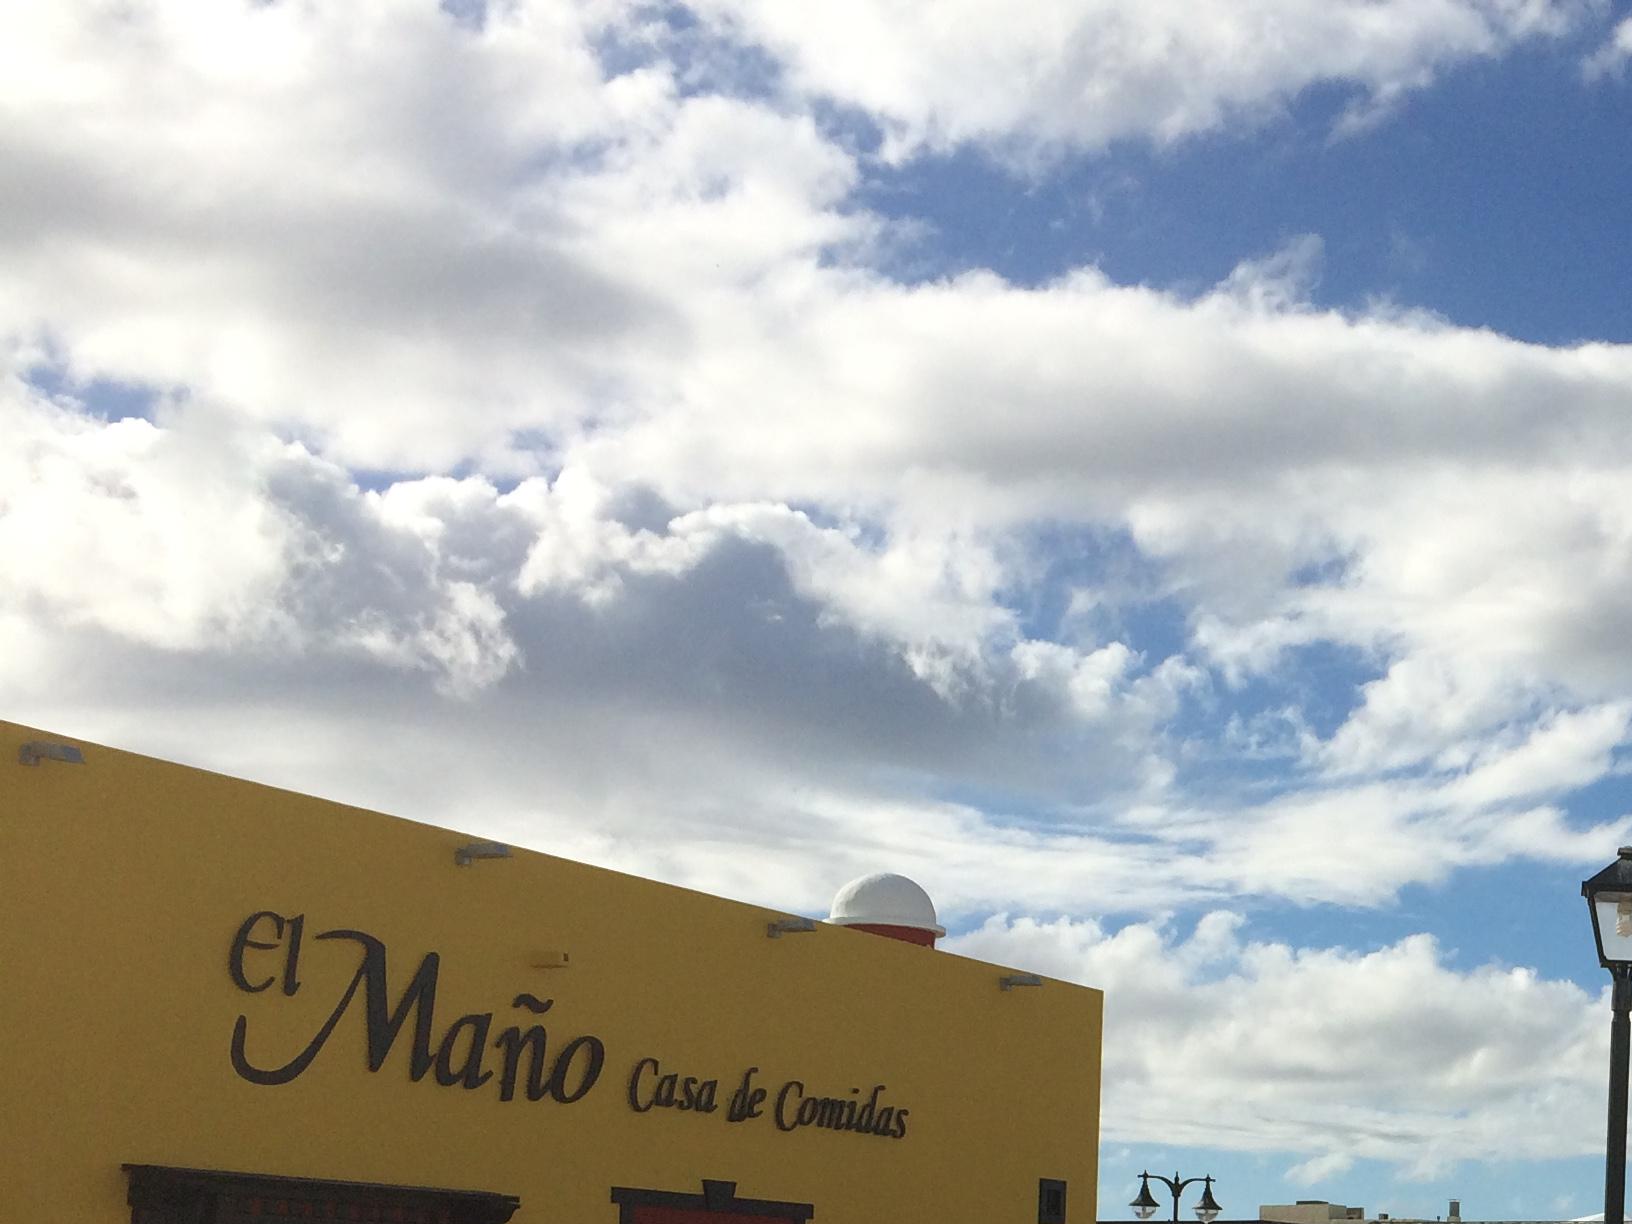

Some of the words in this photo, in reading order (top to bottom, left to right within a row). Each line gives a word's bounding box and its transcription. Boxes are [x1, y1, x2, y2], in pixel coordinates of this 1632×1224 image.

[229, 911, 304, 996] El
[231, 930, 605, 1104] Maño
[628, 1057, 718, 1113] Casa
[727, 1067, 767, 1122] de
[774, 1080, 909, 1139] Comidas
